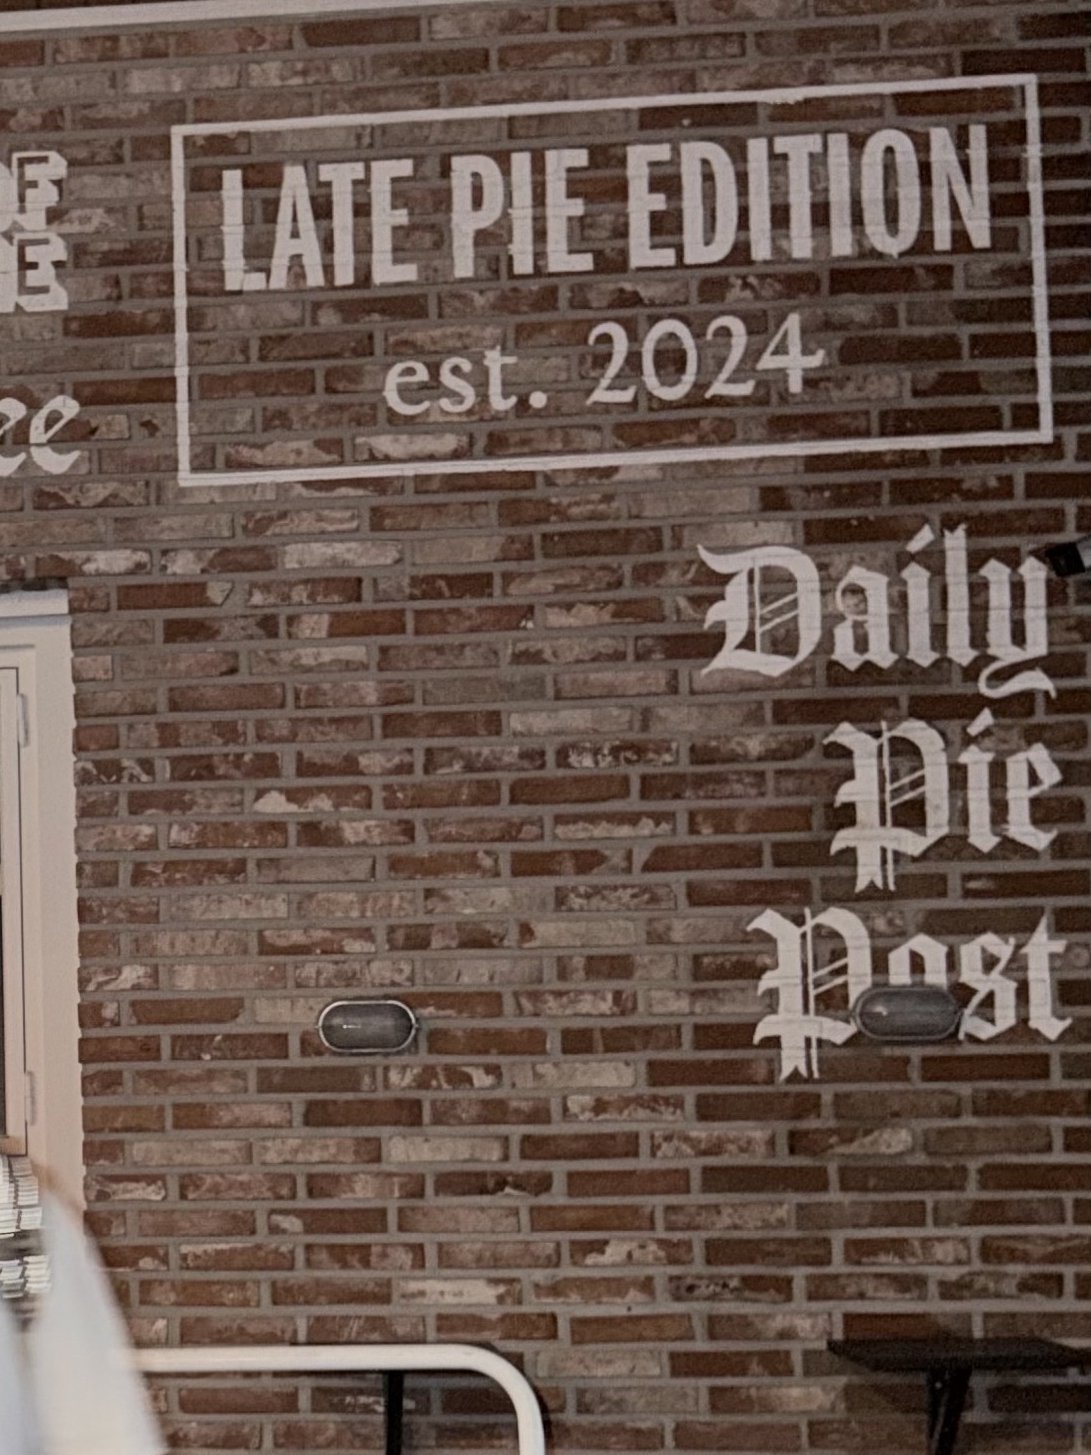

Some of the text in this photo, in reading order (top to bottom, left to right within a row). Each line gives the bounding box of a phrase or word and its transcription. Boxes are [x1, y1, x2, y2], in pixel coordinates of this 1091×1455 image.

[220, 124, 992, 291] LATE PIE EDITION
[382, 311, 826, 417] est. 2024
[697, 523, 1056, 700] Daily
[822, 707, 1063, 893] Pie
